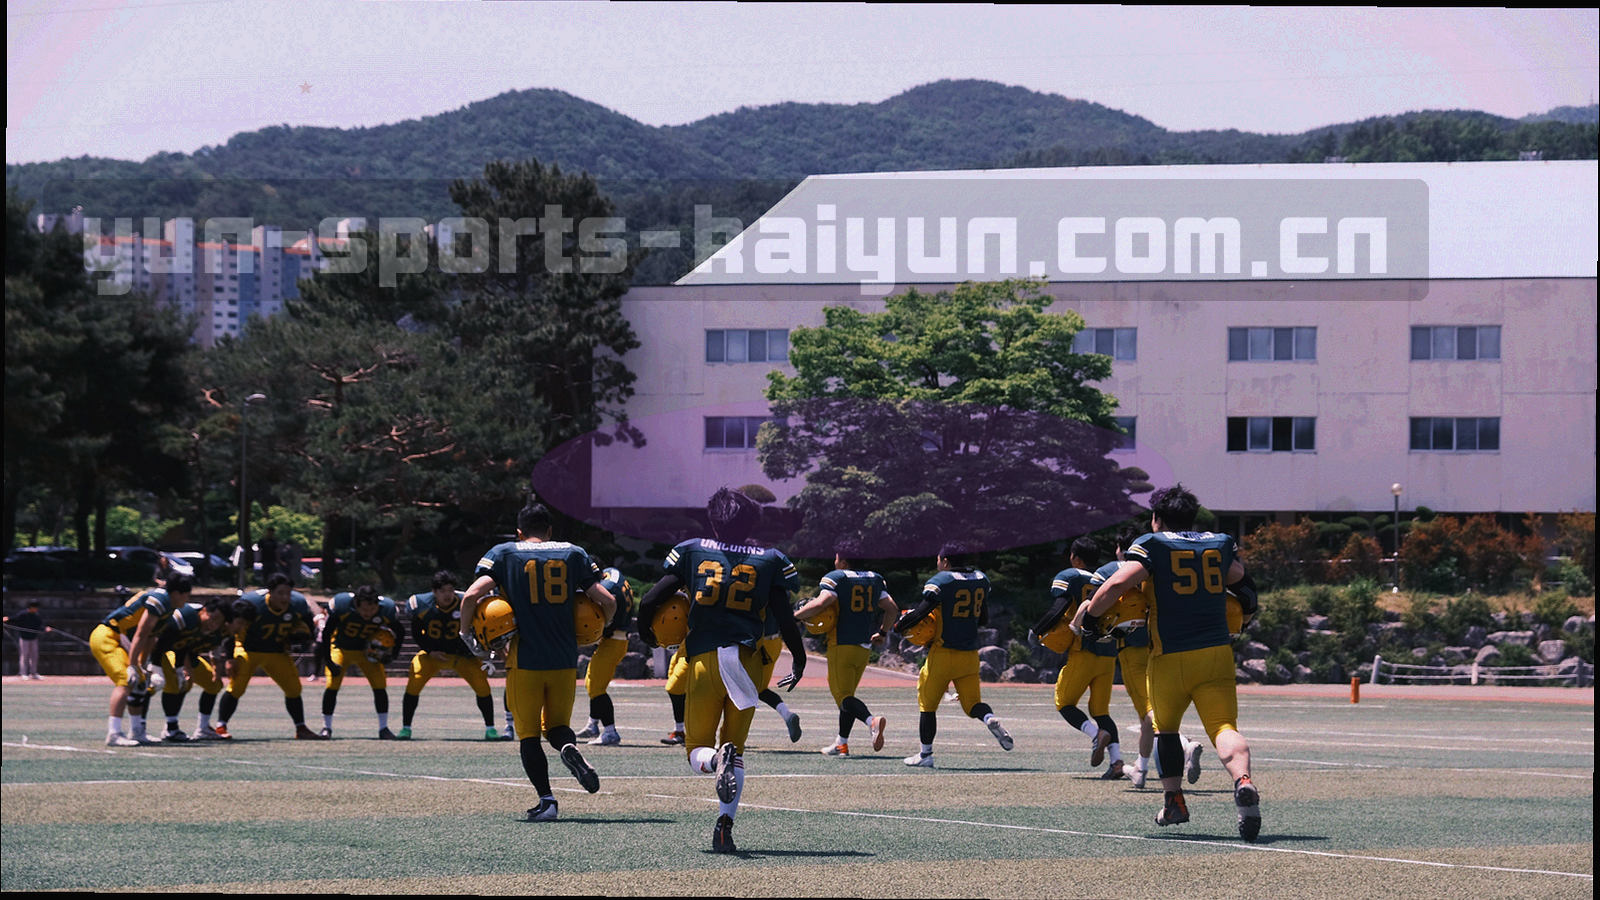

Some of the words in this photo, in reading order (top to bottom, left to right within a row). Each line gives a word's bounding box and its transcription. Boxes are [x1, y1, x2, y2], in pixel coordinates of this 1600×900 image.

[524, 559, 568, 604] 18
[695, 560, 757, 611] 32
[1170, 549, 1223, 595] 56
[851, 585, 874, 612] 61
[952, 587, 985, 618] 28
[262, 622, 293, 643] 75
[428, 619, 460, 640] 63
